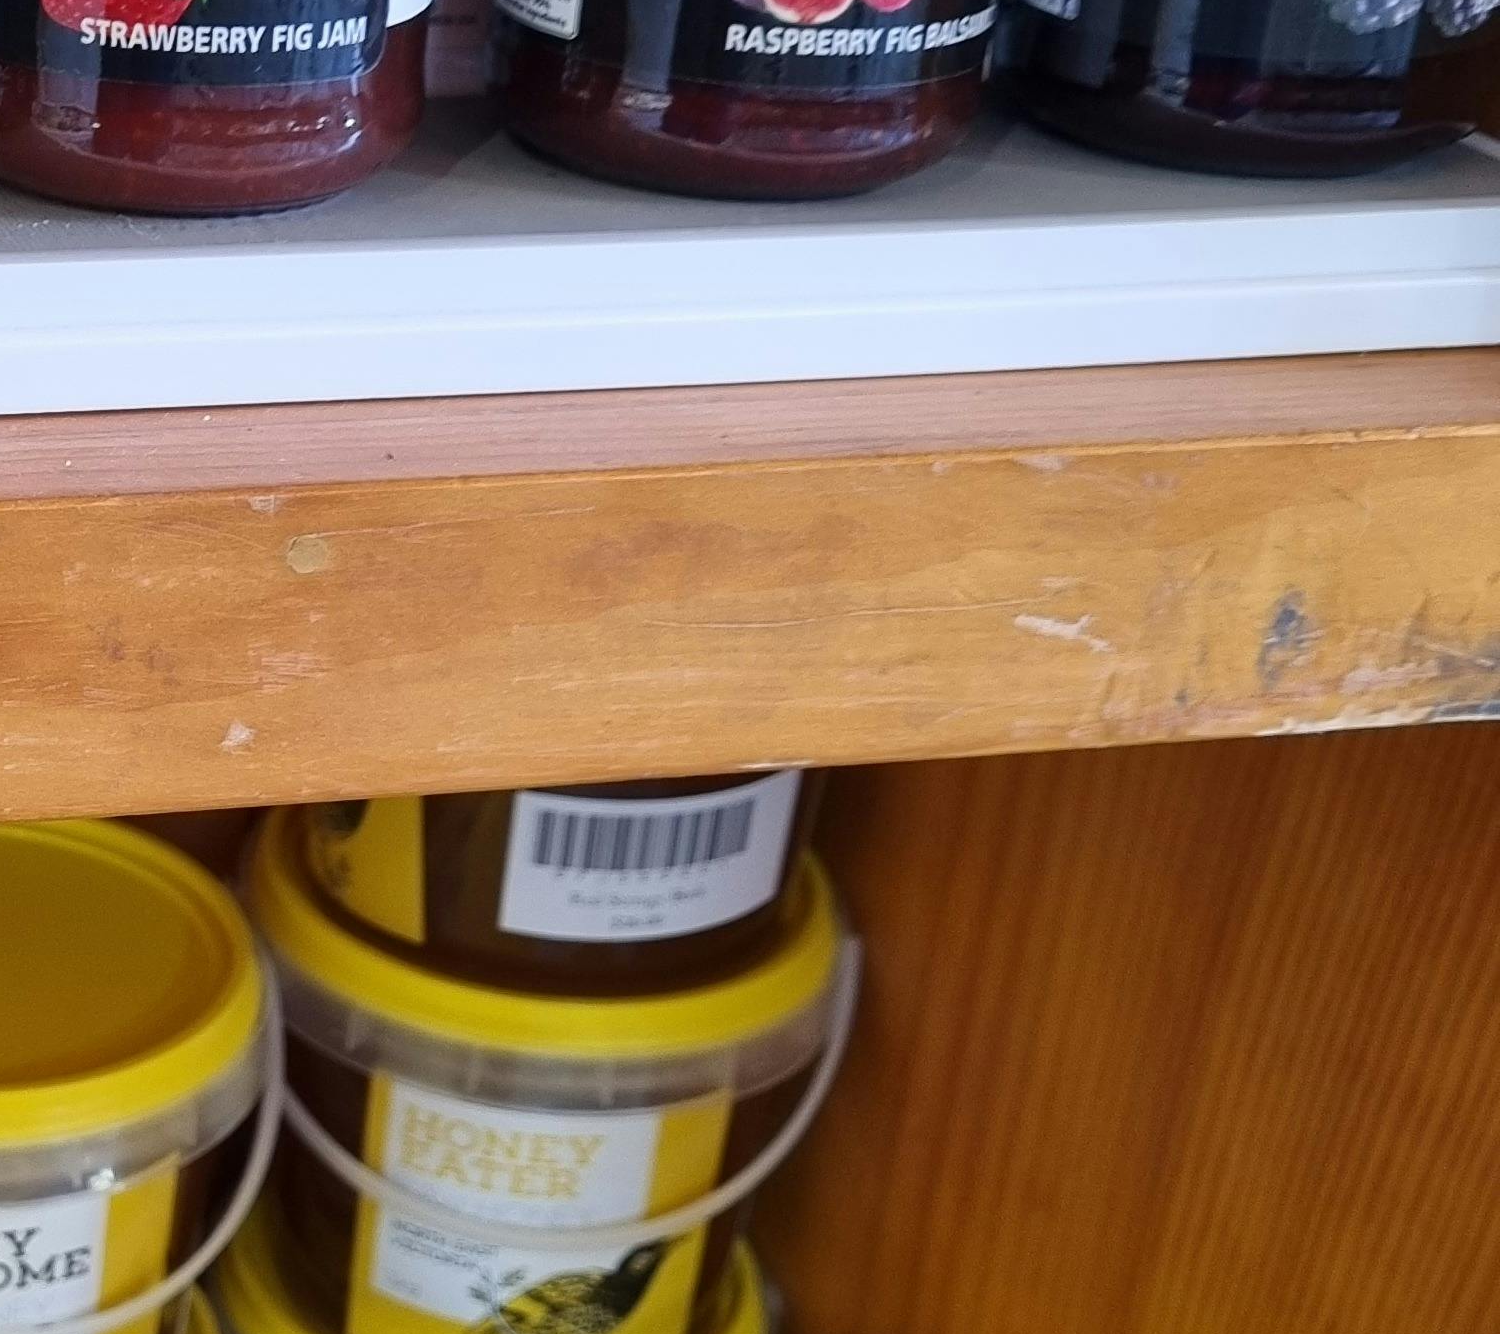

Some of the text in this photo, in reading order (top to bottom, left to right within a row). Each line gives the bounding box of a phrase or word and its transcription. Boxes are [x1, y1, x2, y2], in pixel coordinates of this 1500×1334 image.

[80, 16, 368, 54] STRAWBERRY FIG JAM
[724, 24, 885, 56] RASPBERRY
[883, 24, 925, 55] FIG
[402, 1105, 606, 1169] HONEY
[402, 1138, 584, 1200] EATER
